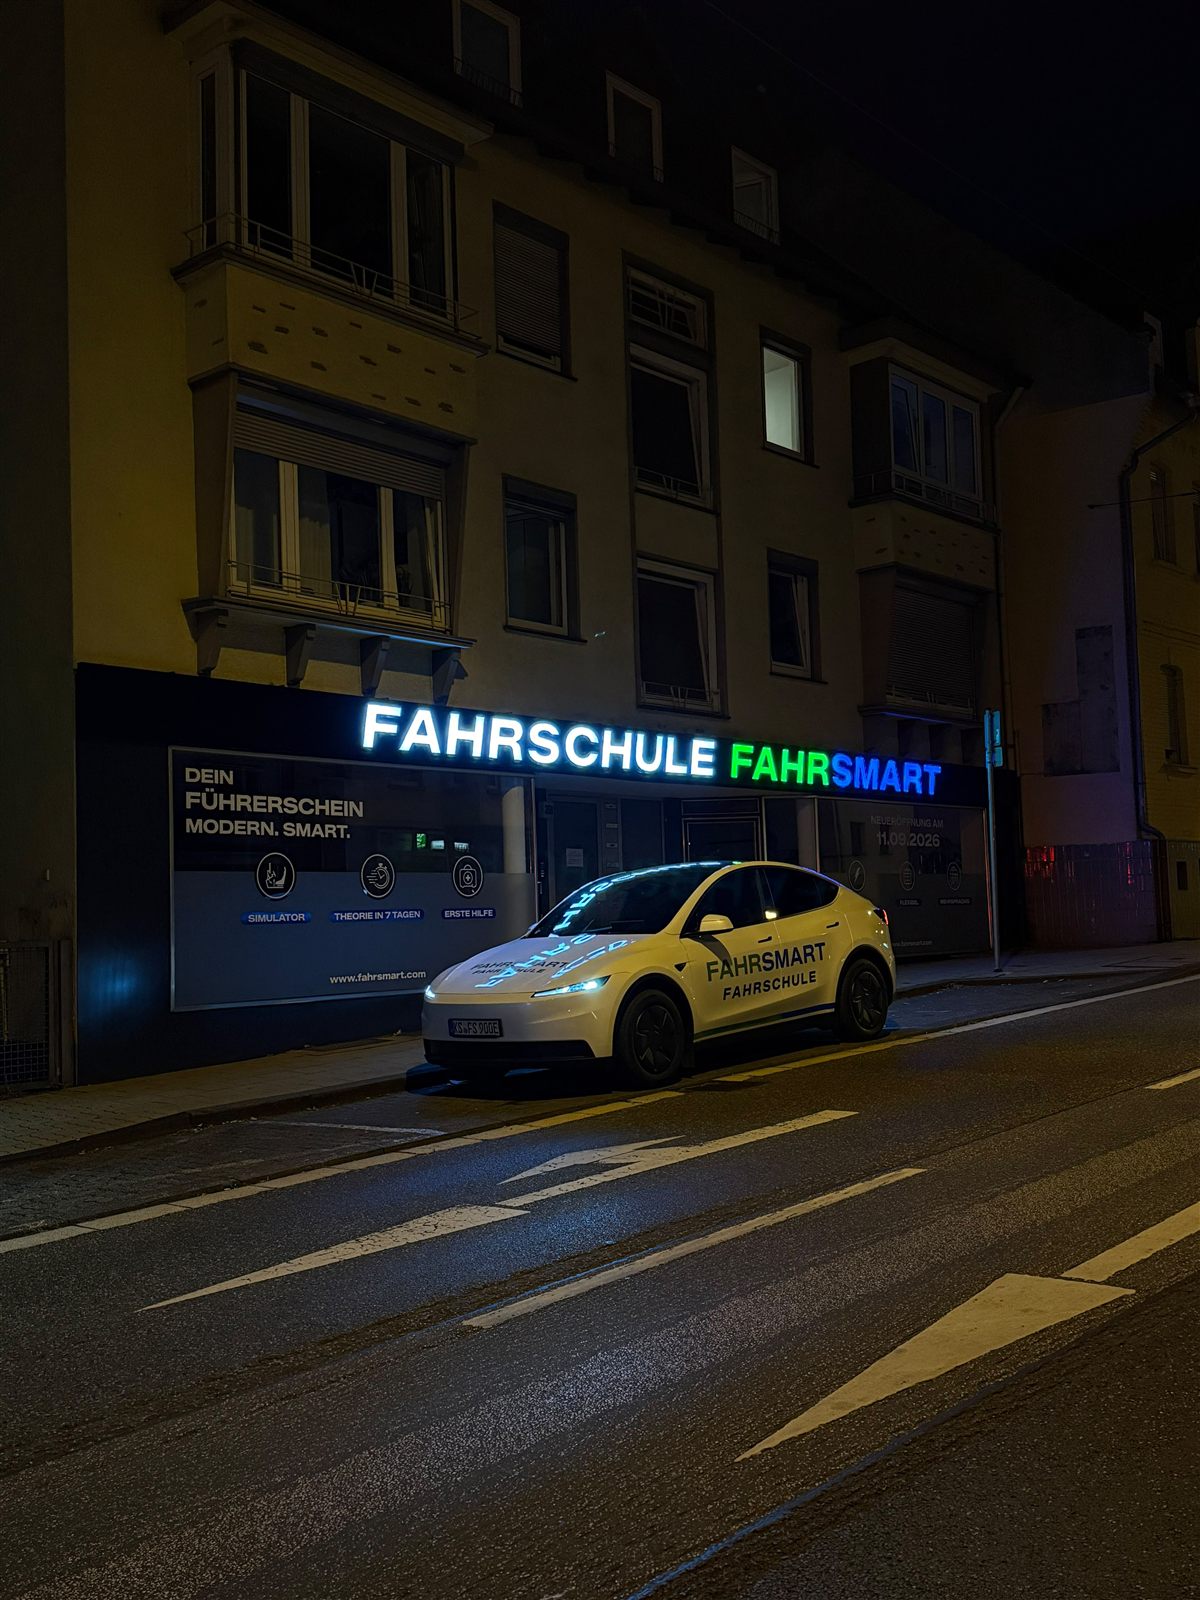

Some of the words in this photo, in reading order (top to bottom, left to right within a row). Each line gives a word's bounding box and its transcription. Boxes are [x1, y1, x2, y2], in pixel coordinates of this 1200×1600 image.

[362, 702, 717, 777] FAHRSCHULE
[730, 742, 942, 796] FAHRSMART
[185, 767, 234, 785] DEIN
[185, 788, 364, 817] FÜHRERSCHEIN
[185, 818, 279, 836] MODERN.
[283, 822, 351, 839] SMART.
[876, 831, 941, 848] 11.09.2026
[248, 913, 306, 923] SIMULATOR
[334, 912, 373, 921] THEORIE
[374, 912, 384, 920] IN
[385, 911, 392, 920] 7
[392, 910, 421, 920] TAGEN
[444, 909, 471, 918] ERSTE
[471, 909, 494, 918] HILFE
[706, 942, 826, 982] FAHRSMART
[329, 970, 427, 984] www.fahrsmart.com
[723, 970, 817, 1001] FAHRSCHULE
